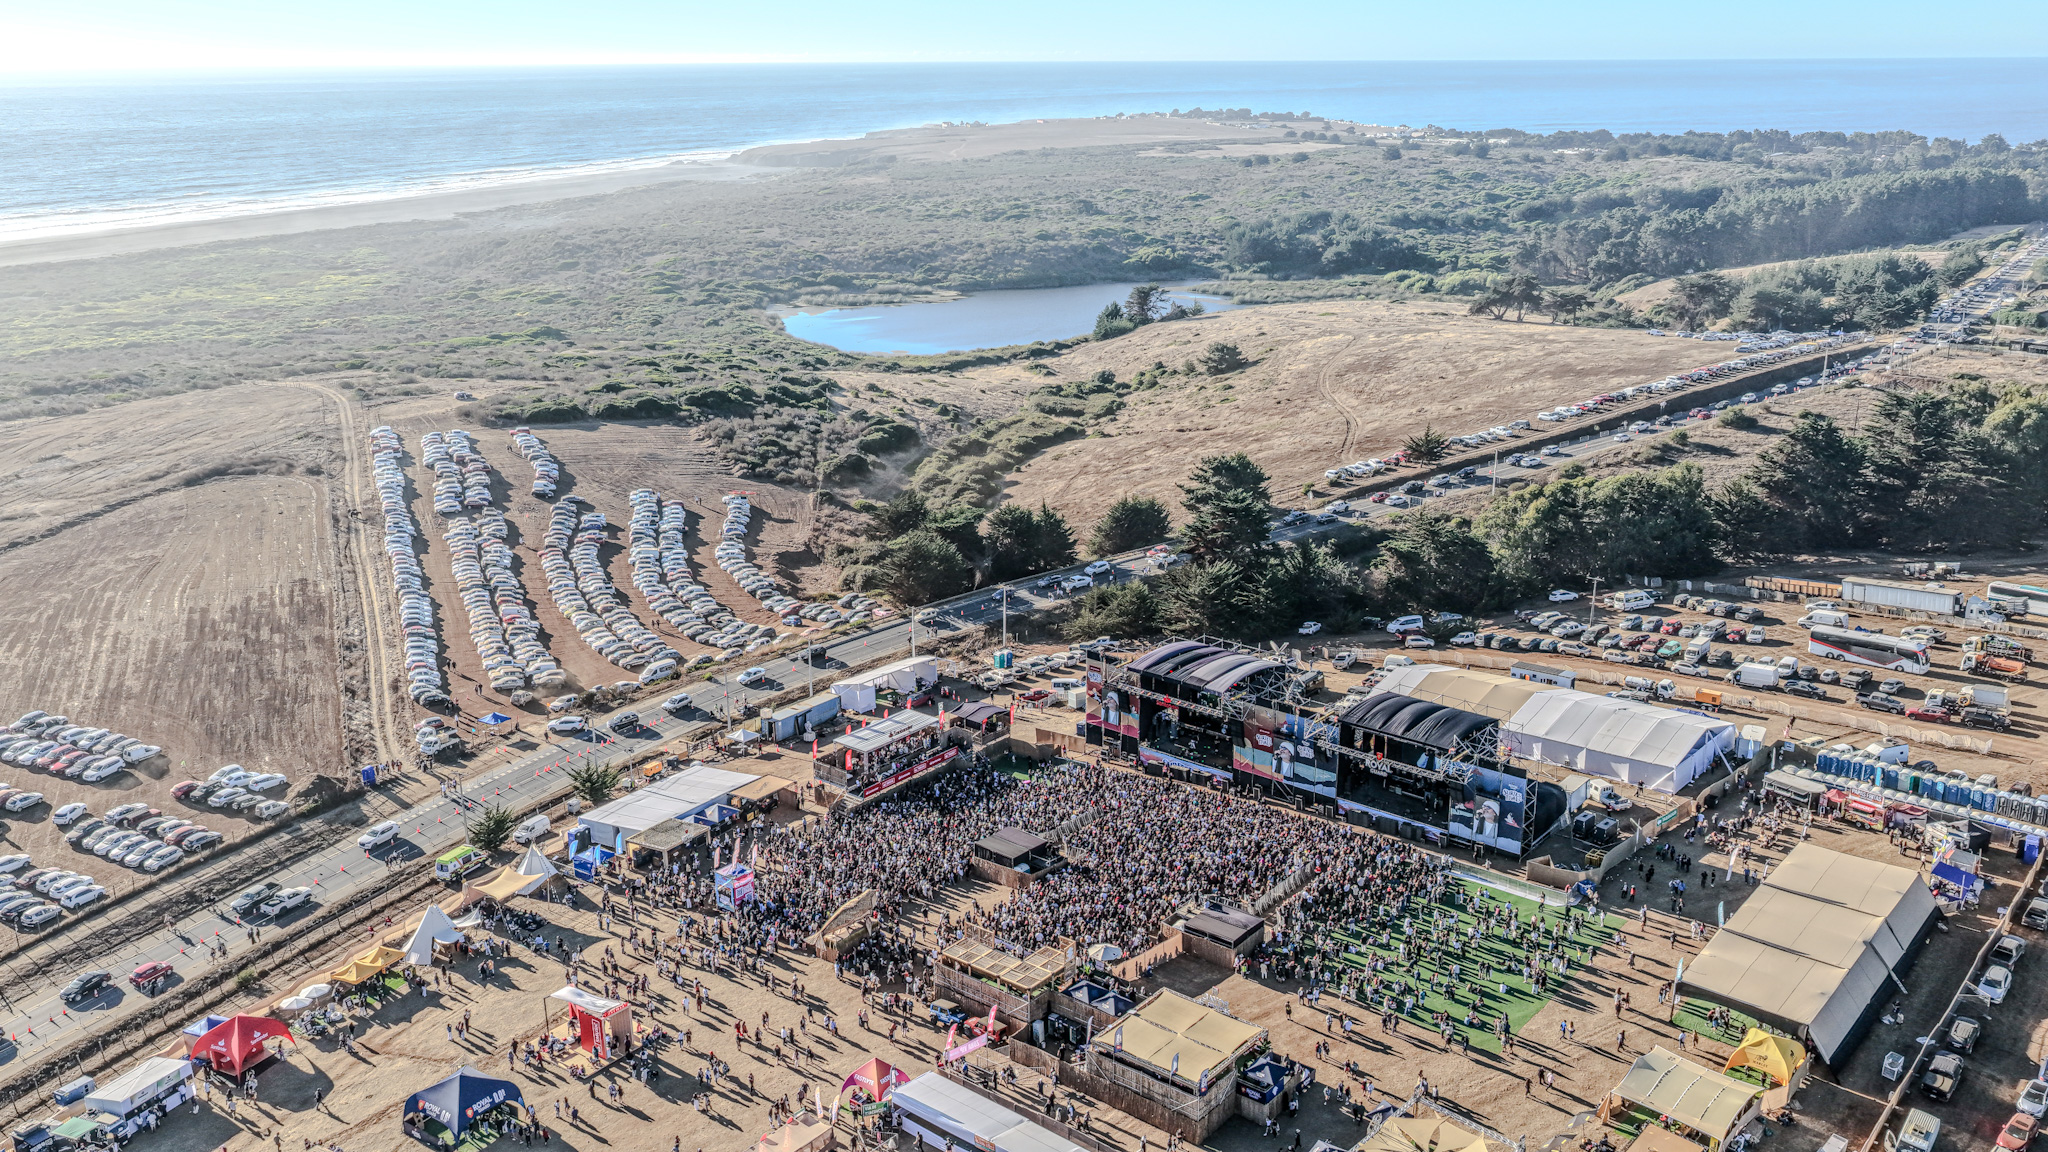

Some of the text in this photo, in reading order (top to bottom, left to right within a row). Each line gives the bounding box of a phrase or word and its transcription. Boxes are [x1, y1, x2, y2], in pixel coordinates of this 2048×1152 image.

[1365, 759, 1392, 773] ROYAL
[250, 1032, 269, 1045] Santander
[210, 1044, 227, 1052] Santander
[854, 1074, 874, 1085] FASTLYTE
[424, 1102, 441, 1114] ROYAL
[472, 1096, 493, 1110] ROYAL
